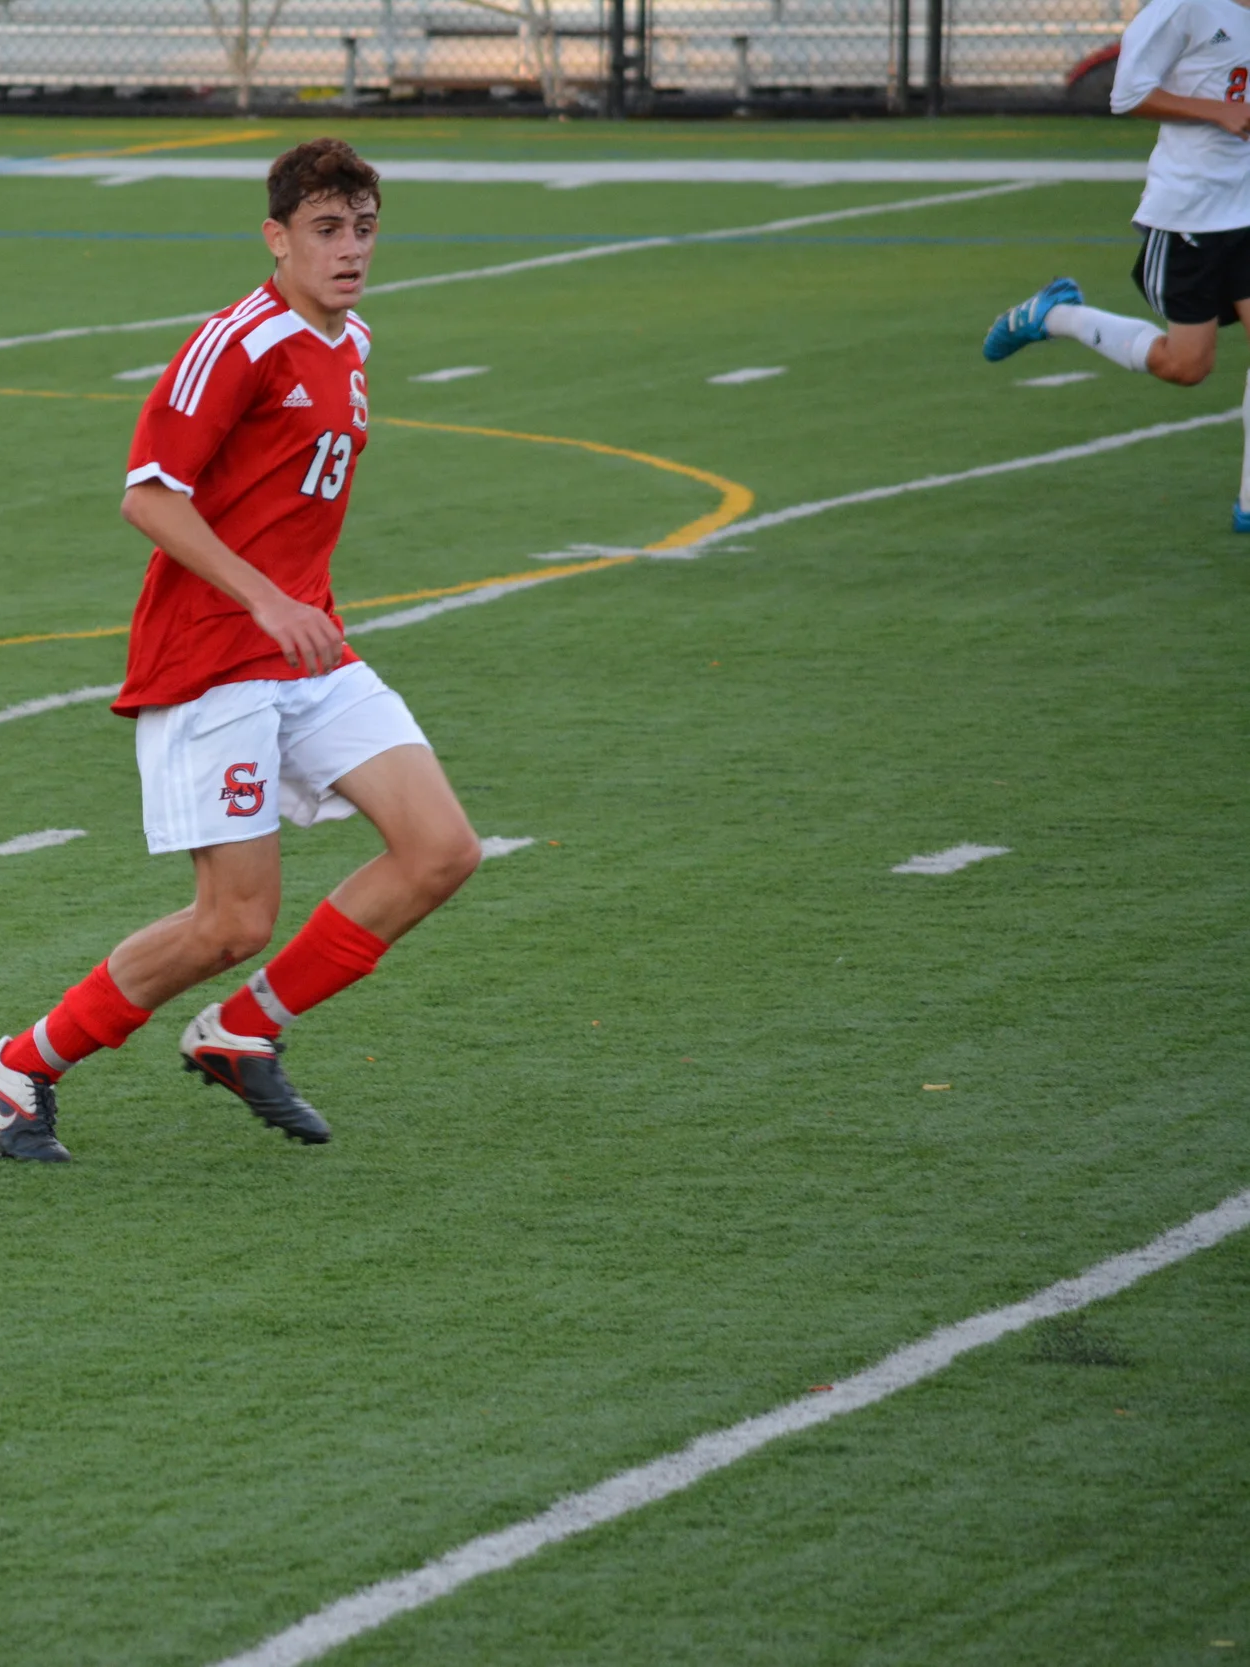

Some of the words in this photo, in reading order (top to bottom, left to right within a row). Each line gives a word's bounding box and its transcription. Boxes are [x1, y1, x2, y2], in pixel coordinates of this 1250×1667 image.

[281, 398, 314, 408] adidas
[349, 369, 369, 432] S
[299, 429, 354, 502] 13
[218, 778, 268, 801] EAST
[223, 761, 266, 818] S
